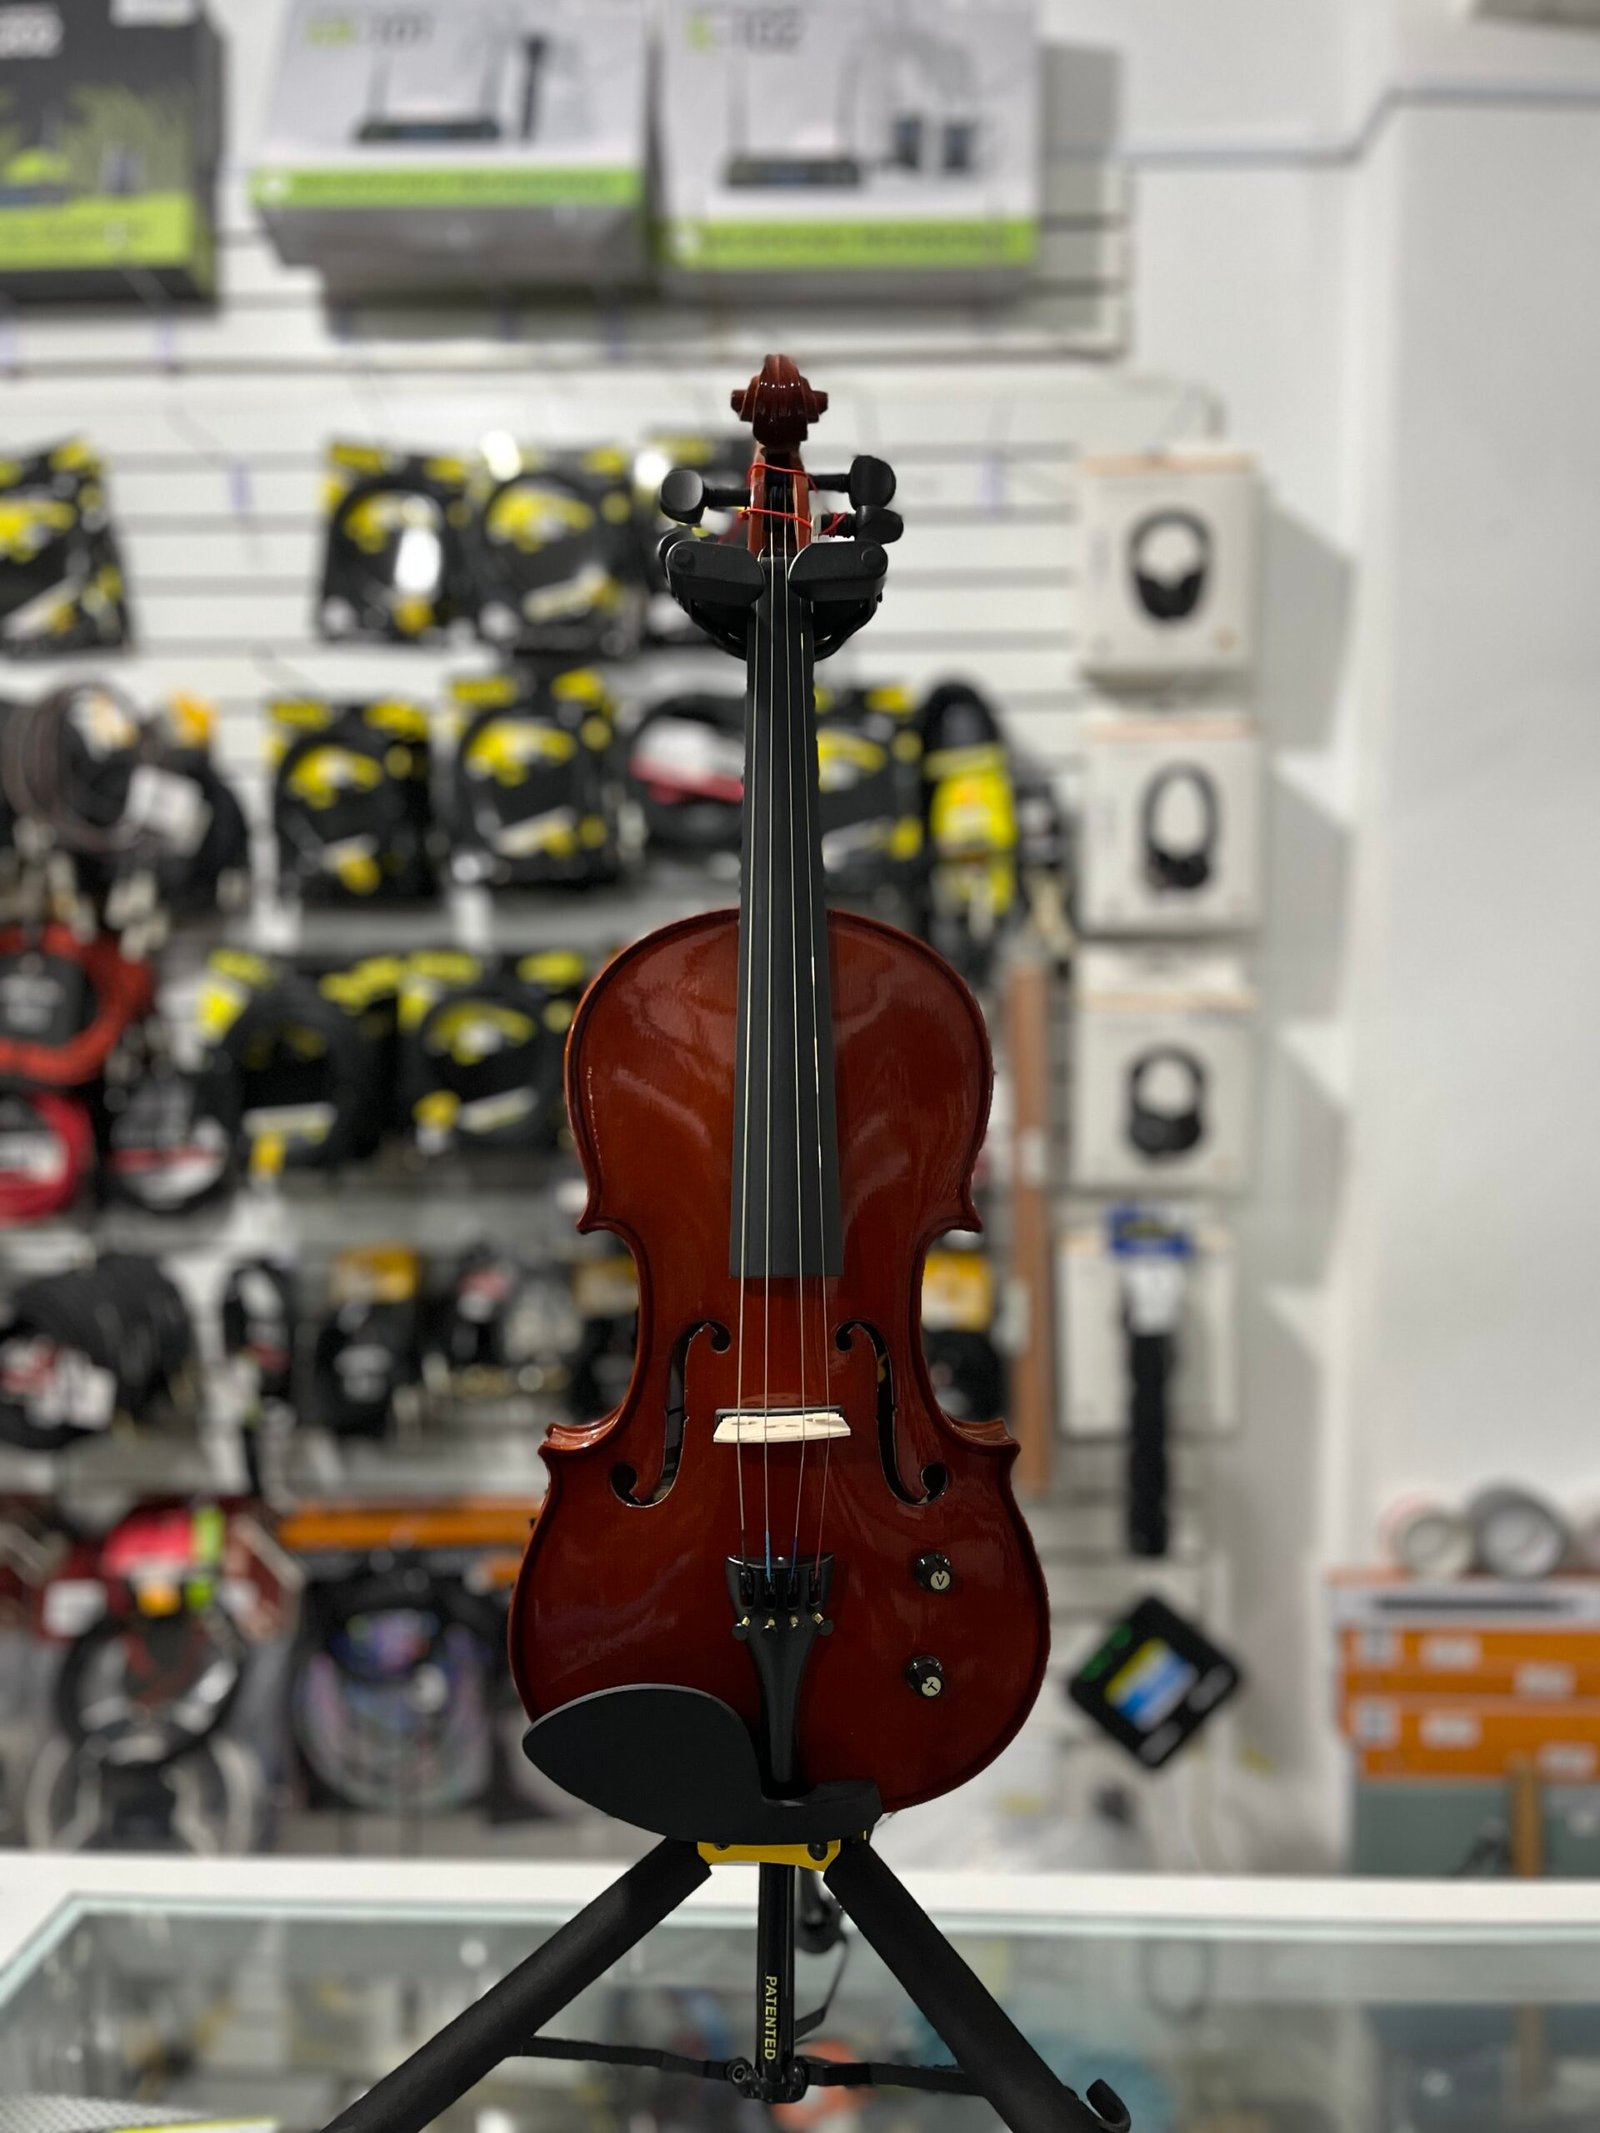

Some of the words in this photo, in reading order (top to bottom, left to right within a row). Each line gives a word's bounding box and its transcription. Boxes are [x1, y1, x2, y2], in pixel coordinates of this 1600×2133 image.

[936, 1575, 945, 1587] V
[927, 1681, 938, 1692] T
[764, 1975, 778, 2060] PATENTED
